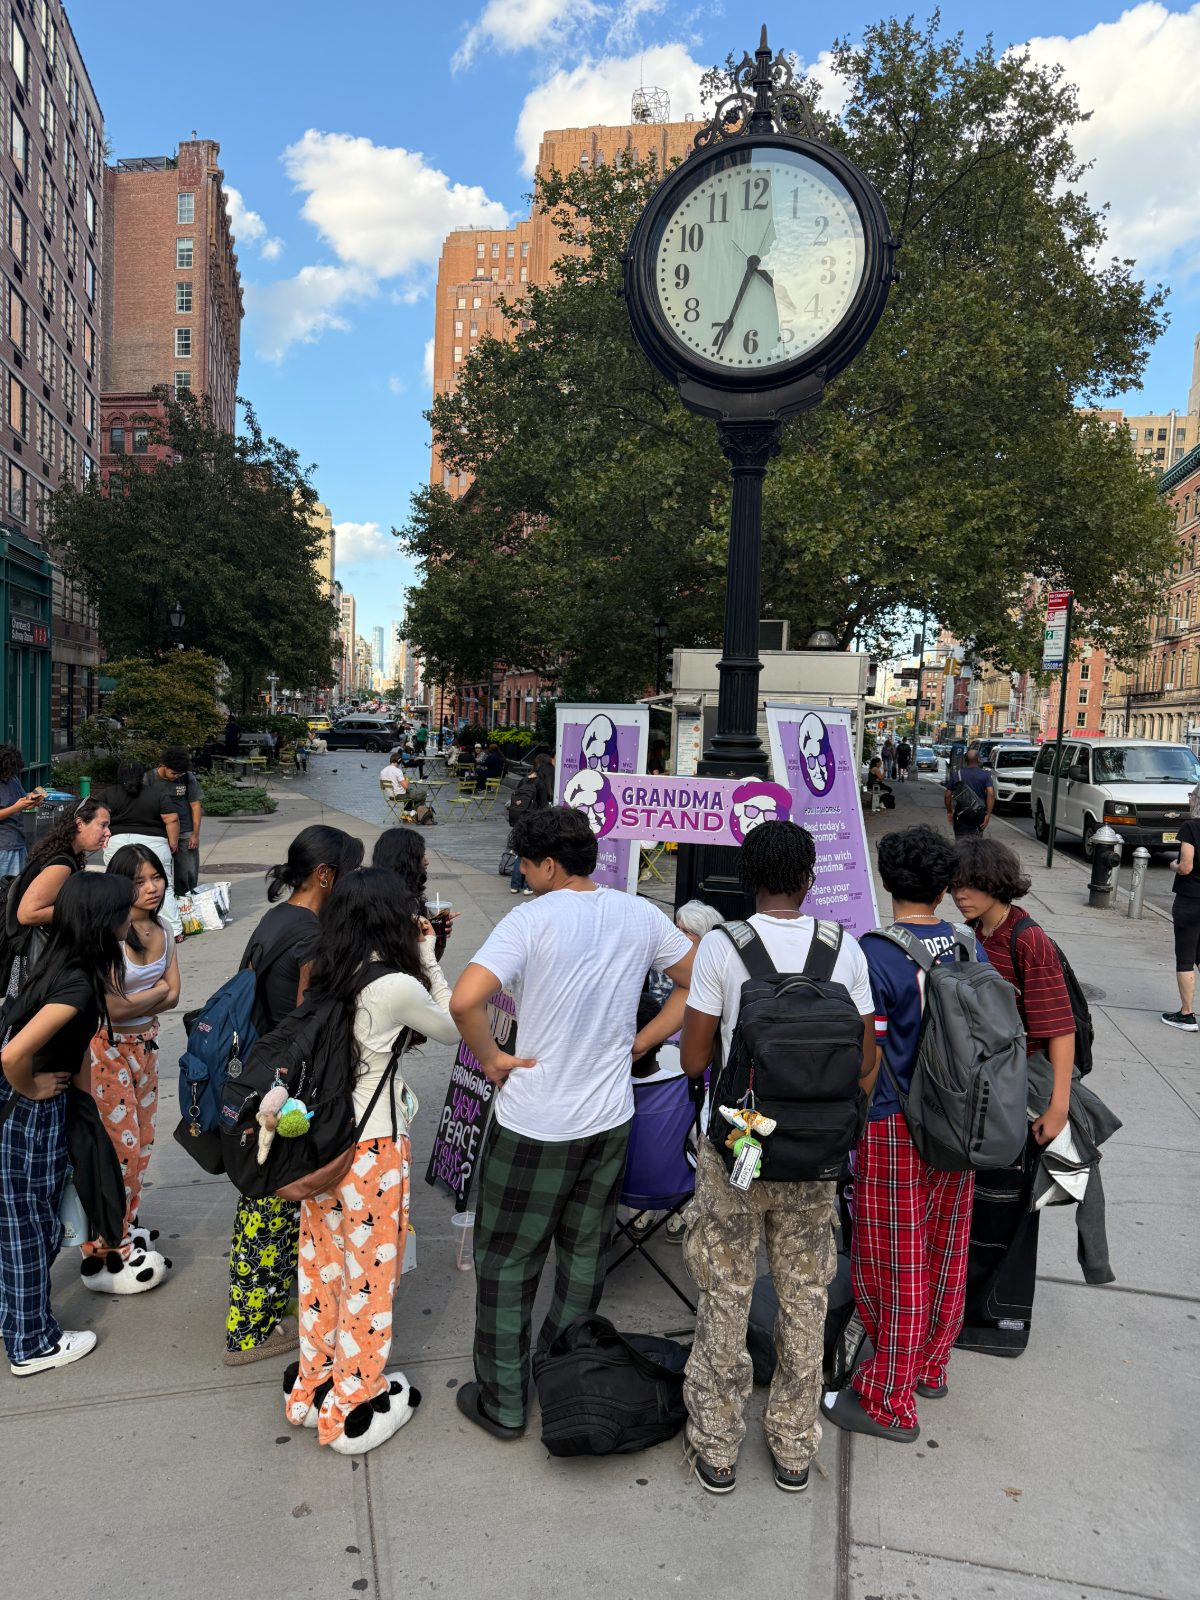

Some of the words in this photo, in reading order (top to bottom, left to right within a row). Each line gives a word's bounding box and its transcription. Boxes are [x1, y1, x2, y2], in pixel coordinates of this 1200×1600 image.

[706, 192, 729, 224] 11
[741, 178, 770, 211] 12
[790, 186, 801, 220] 1
[677, 223, 704, 253] 10
[813, 216, 830, 247] 2
[674, 263, 690, 290] 9
[820, 256, 837, 285] 3
[684, 297, 700, 323] 8
[804, 293, 823, 320] 4
[711, 322, 730, 347] 7
[743, 329, 759, 355] 6
[780, 319, 796, 344] 5
[622, 787, 724, 811] GRANDMA
[621, 808, 725, 832] STAND
[819, 820, 846, 832] today's
[812, 862, 844, 875] grandma
[834, 850, 852, 860] with
[812, 884, 831, 896] Share
[832, 883, 850, 894] your
[815, 893, 849, 906] response
[452, 1064, 492, 1102] BRINGING
[453, 1087, 480, 1124] you
[440, 1106, 480, 1161] PEACE
[435, 1136, 462, 1172] right
